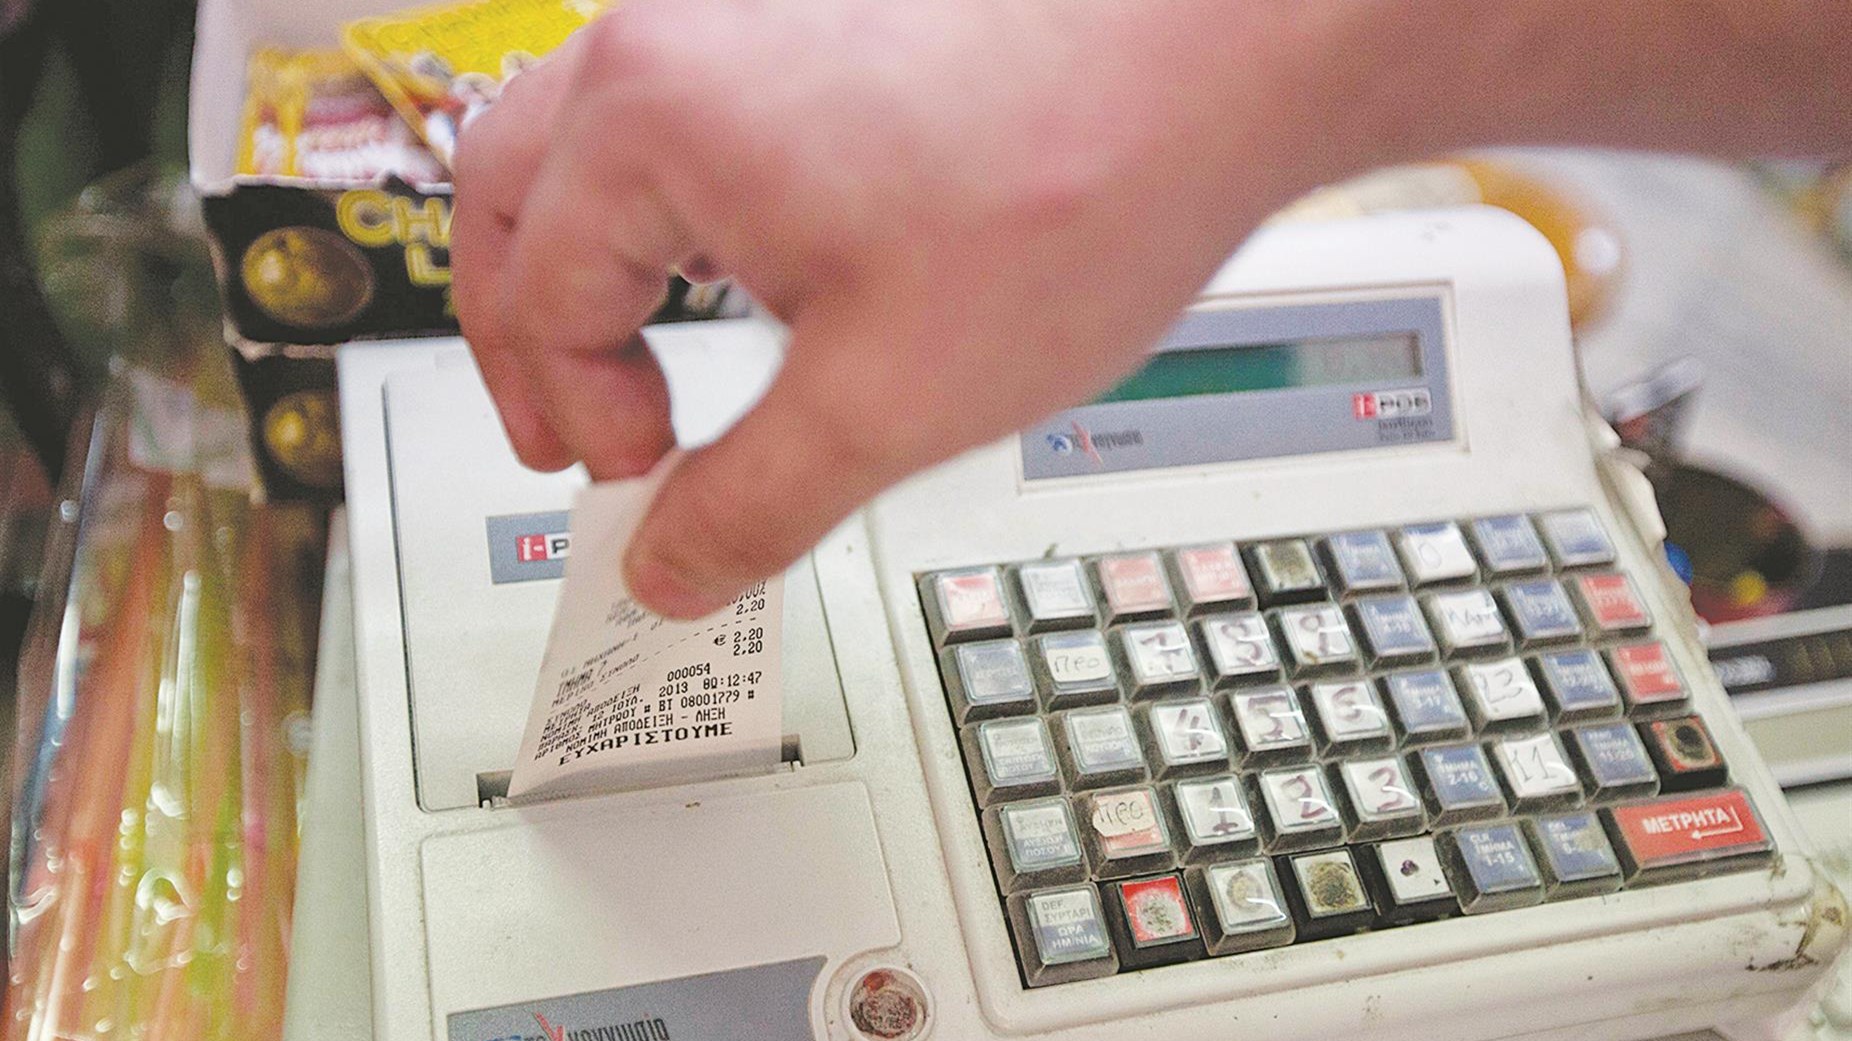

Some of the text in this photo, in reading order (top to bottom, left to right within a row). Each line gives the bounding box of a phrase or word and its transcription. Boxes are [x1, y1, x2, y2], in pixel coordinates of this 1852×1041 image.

[736, 598, 765, 615] 2,20
[733, 627, 763, 643] 2,20
[733, 640, 763, 656] 2,20
[667, 662, 711, 682] 000054
[659, 681, 689, 697] 2013
[613, 713, 673, 735] ΑΠΟΔΕΙΞΗ
[558, 722, 733, 766] ΕΥΧΑΡΙΣΤΟΥΜΕ
[1641, 806, 1731, 834] ΜΕΤΡΗΤΑ
